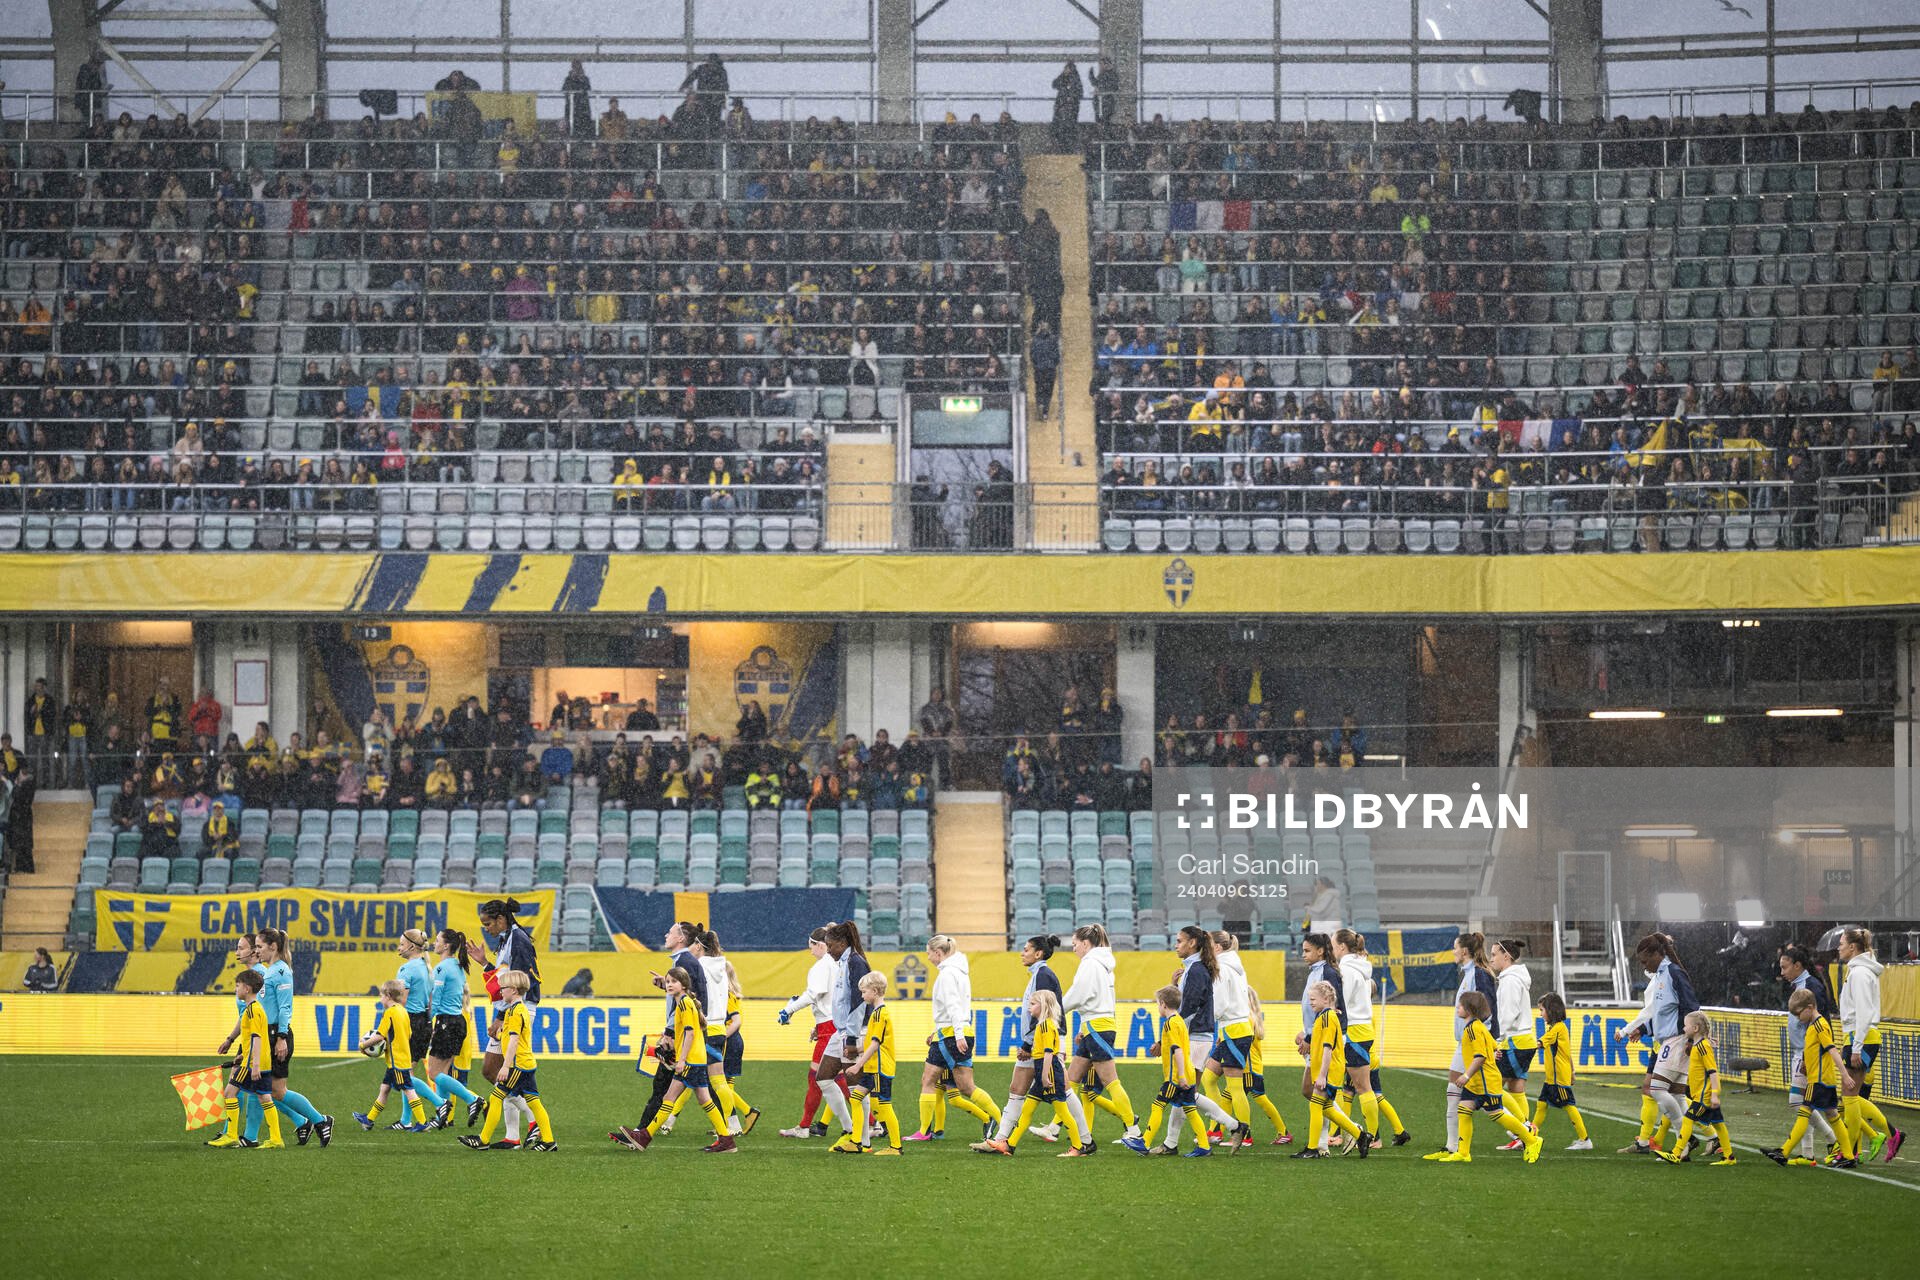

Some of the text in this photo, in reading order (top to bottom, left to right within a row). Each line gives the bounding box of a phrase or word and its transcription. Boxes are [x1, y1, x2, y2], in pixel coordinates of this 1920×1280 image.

[365, 627, 378, 638] 13
[645, 628, 659, 638] 12
[201, 899, 448, 938] CAMP SWEDEN
[315, 1004, 360, 1052] VI
[1661, 1045, 1671, 1059] 8
